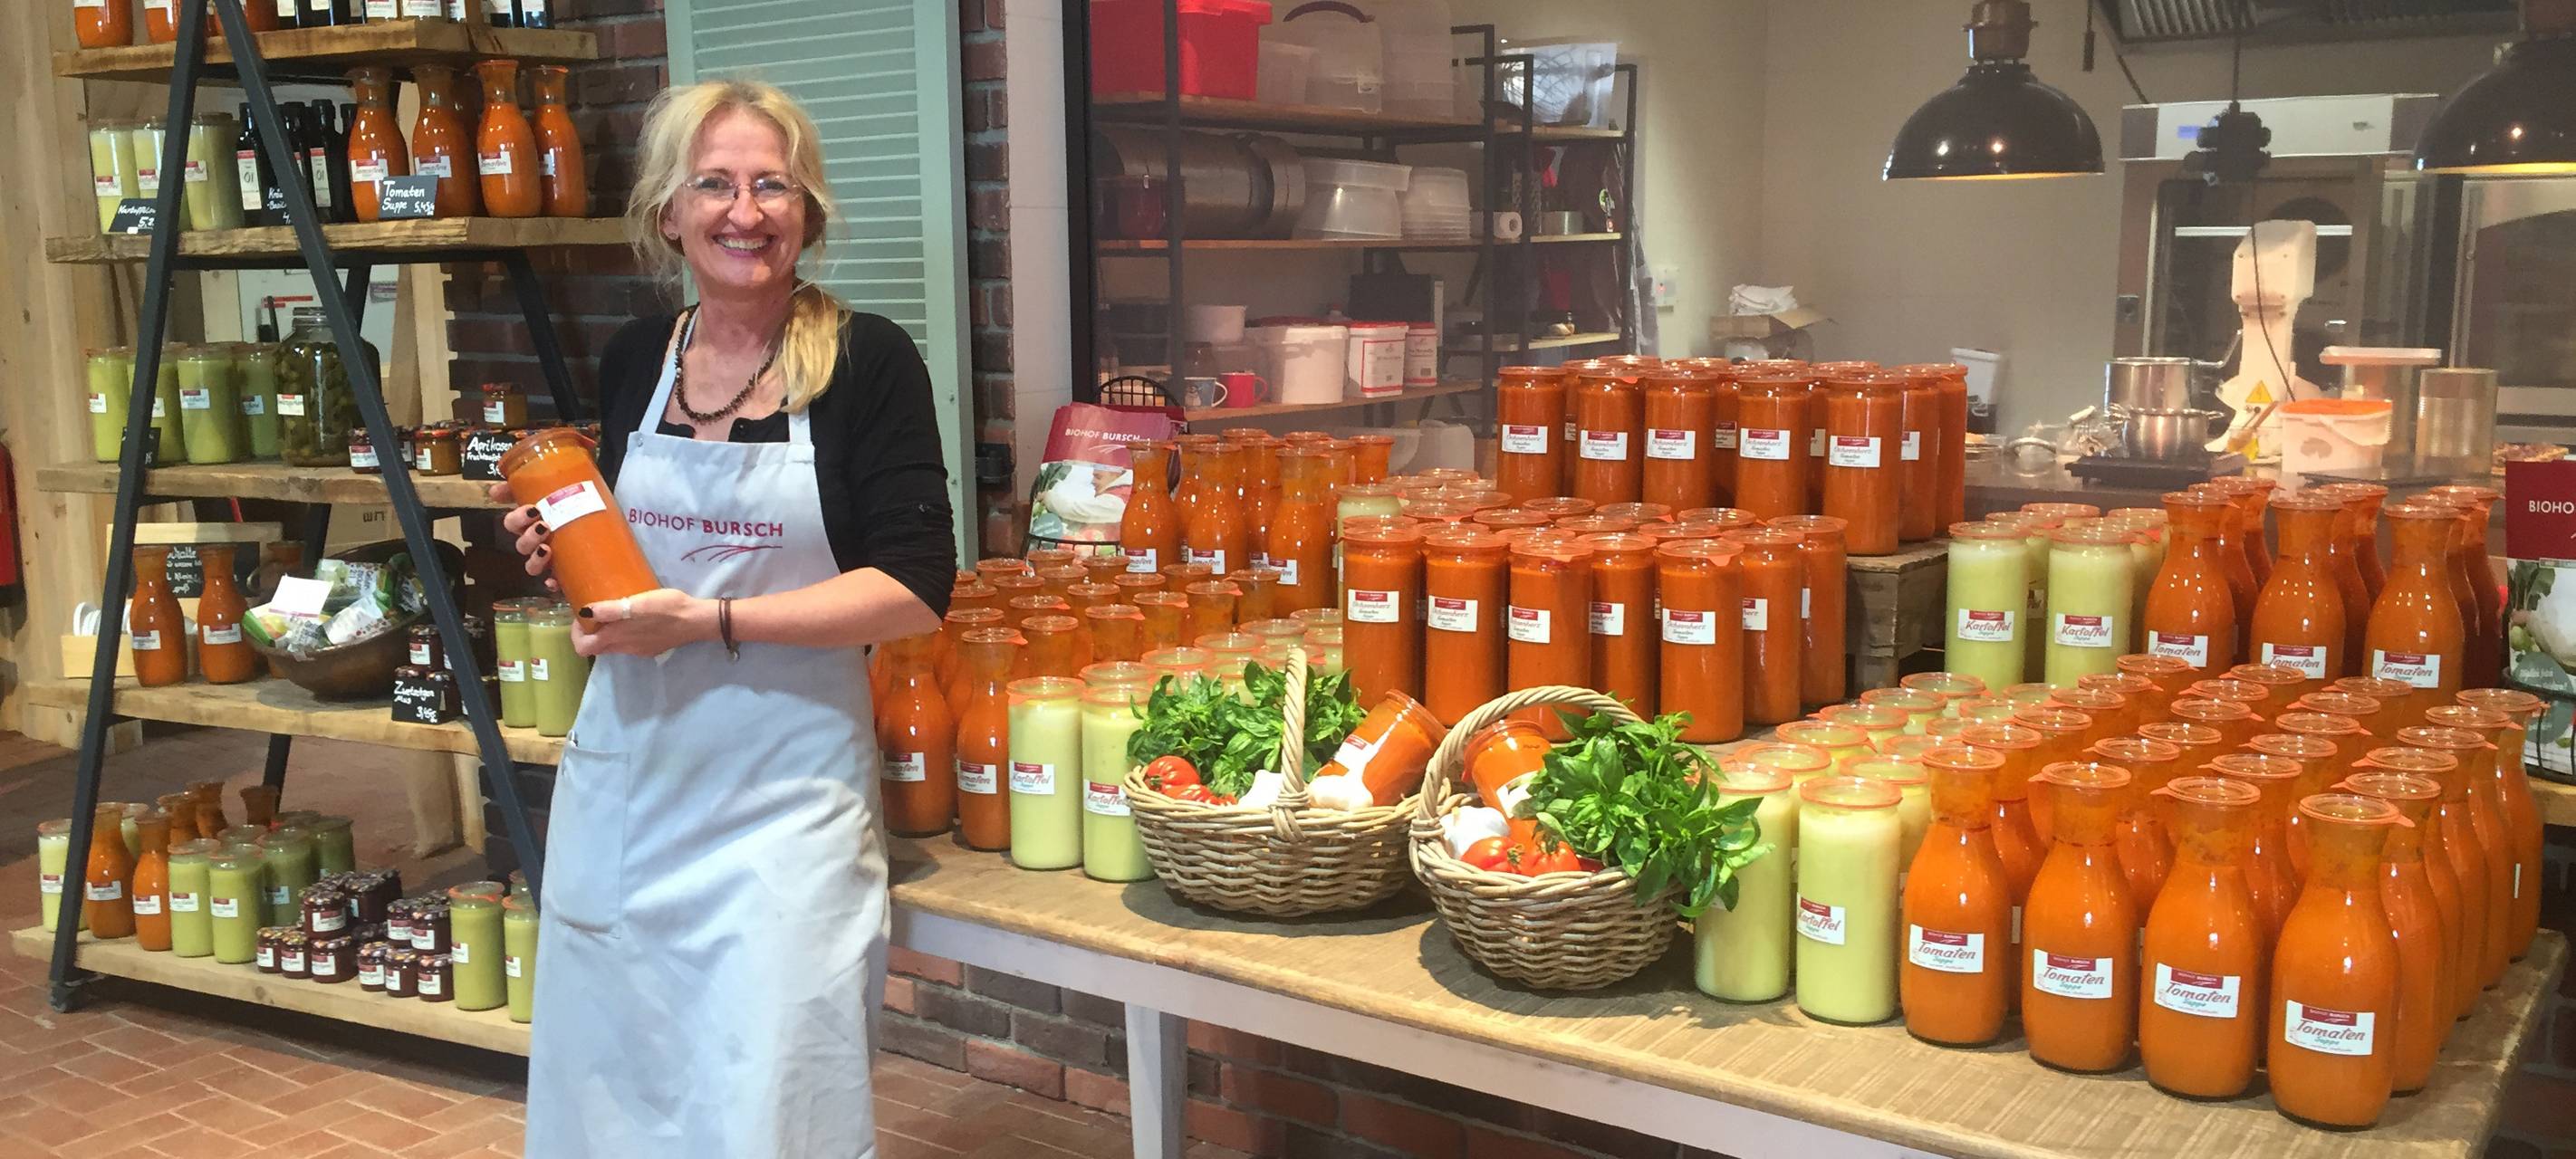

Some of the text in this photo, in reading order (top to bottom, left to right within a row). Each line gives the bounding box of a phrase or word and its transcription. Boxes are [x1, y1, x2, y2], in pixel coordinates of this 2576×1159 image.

[383, 180, 426, 197] Tomaten
[381, 196, 408, 214] Suppe
[1064, 428, 1141, 442] BIOHOF BURSCH
[2528, 500, 2575, 514] BIOHO
[629, 508, 783, 537] BIOHOF BURSCH
[1966, 620, 2013, 632] Kartoffel
[2061, 625, 2110, 637] Kartoffel
[2154, 643, 2202, 656] Tomaten
[2379, 663, 2434, 677] Tomaten
[1918, 942, 1976, 960] Tomaten
[2043, 966, 2105, 985] Tomaten
[2166, 982, 2231, 1003] Tomaten
[2296, 1020, 2366, 1041] Tomaten
